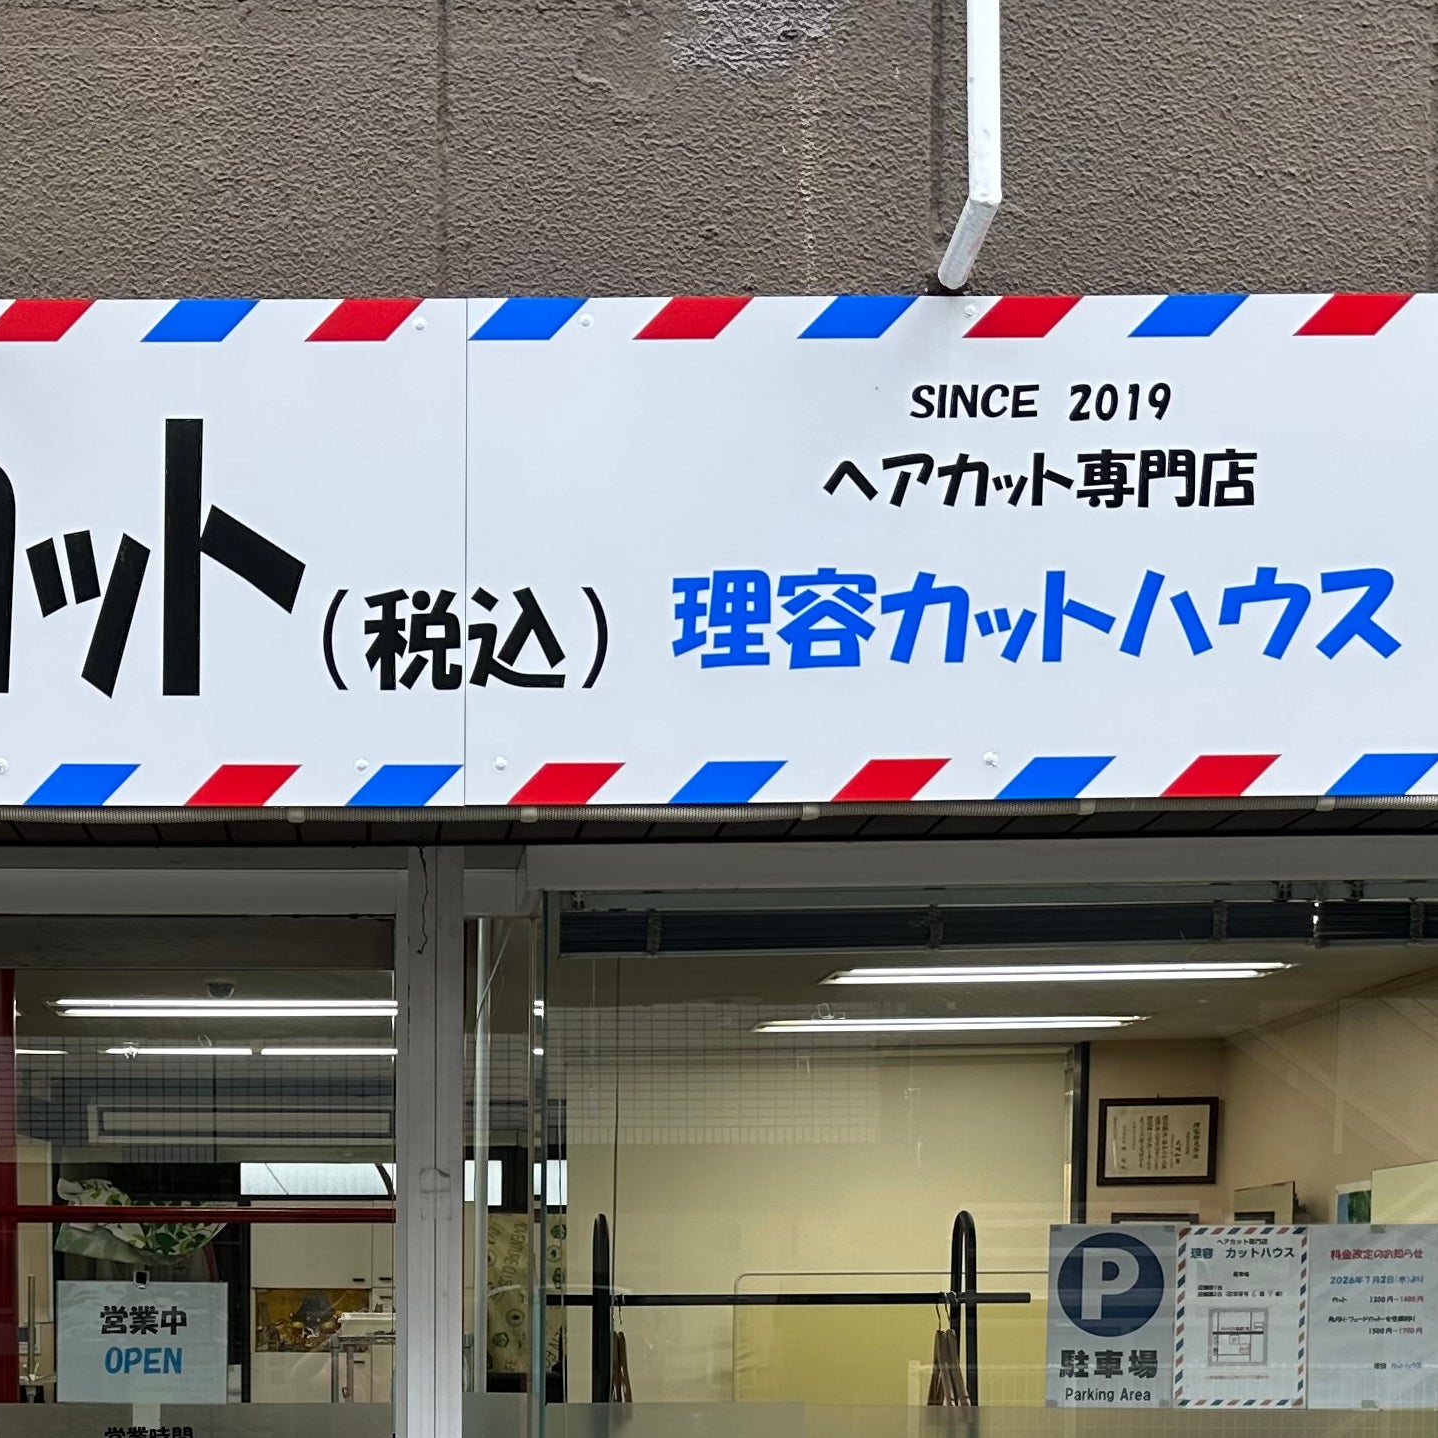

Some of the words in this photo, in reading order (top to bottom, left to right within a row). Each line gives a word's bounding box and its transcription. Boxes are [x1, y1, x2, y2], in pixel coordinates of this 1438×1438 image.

[909, 383, 1040, 420] SINCE
[1069, 382, 1173, 422] 2019
[822, 449, 1258, 509] ヘアカット専門店
[671, 566, 1402, 669] 理容カットハウス
[1081, 1247, 1139, 1320] P
[100, 1306, 188, 1335] 営業中
[104, 1347, 183, 1375] OPEN
[1059, 1349, 1159, 1379] 駐車場
[1065, 1387, 1115, 1402] Parking
[1120, 1387, 1152, 1402] Area
